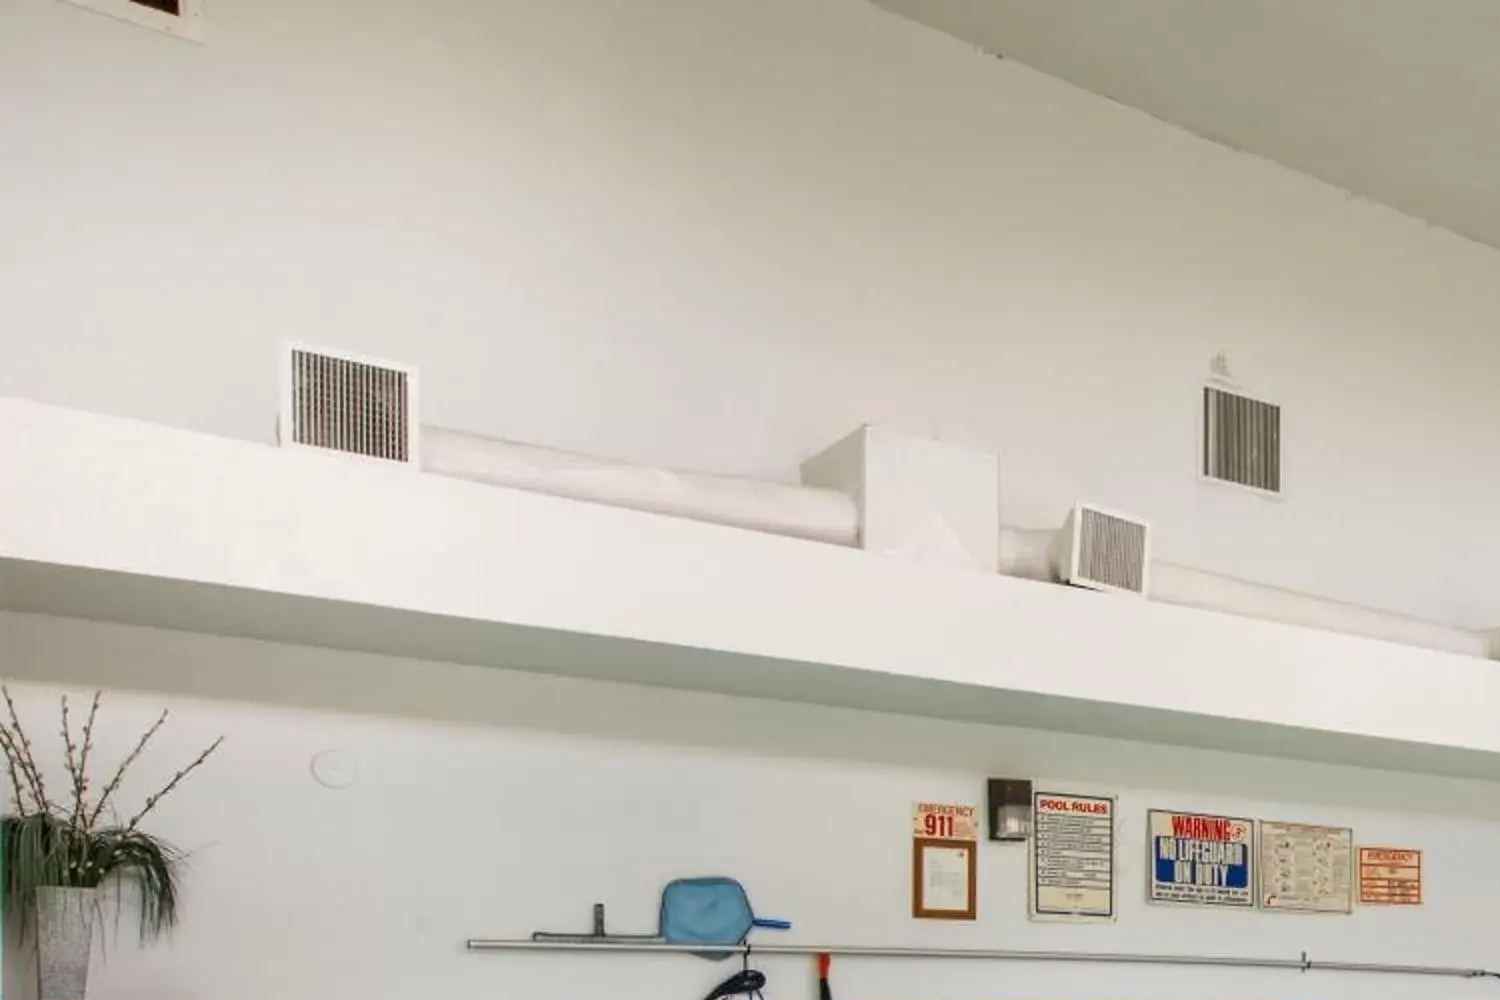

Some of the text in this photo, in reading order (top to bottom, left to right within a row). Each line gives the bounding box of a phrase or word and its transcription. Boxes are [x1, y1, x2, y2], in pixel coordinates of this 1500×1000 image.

[1039, 799, 1108, 814] POOL RULES
[925, 813, 953, 836] 911
[1171, 815, 1231, 841] WARNING
[1178, 838, 1243, 865] LIFEGUARD
[1195, 862, 1228, 887] DUTY
